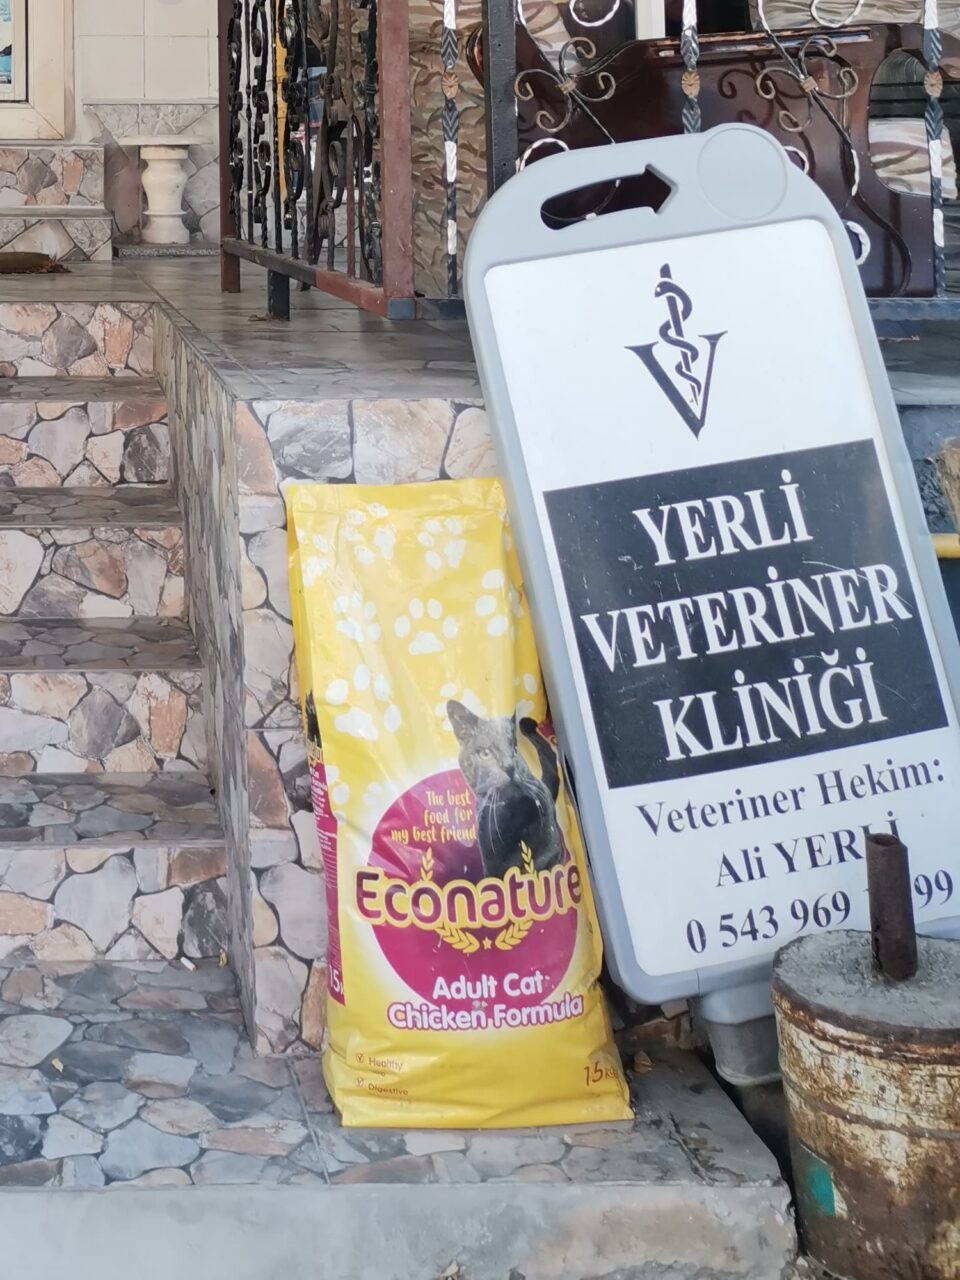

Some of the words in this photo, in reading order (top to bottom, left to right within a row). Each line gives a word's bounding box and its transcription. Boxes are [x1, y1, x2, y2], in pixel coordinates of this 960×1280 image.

[632, 469, 815, 567] YERLİ
[580, 564, 914, 674] VETERİNER
[653, 646, 890, 762] KLİNİĞİ
[424, 809, 450, 827] food
[454, 806, 473, 824] for
[425, 789, 444, 806] The
[446, 788, 472, 806] best
[634, 784, 806, 837] Veteriner
[815, 757, 945, 808] Hekim:
[390, 828, 409, 845] my
[412, 826, 437, 844] best
[440, 823, 477, 844] friend
[715, 845, 769, 888] Ali
[772, 810, 900, 876] YER
[355, 863, 582, 924] Econature
[686, 918, 707, 954] 0
[719, 904, 780, 948] 543
[790, 889, 852, 933] 969
[913, 869, 954, 910] 99
[432, 973, 498, 1000] Adult
[503, 970, 544, 997] Cat
[389, 1002, 488, 1030] Chicken
[493, 992, 583, 1028] Formula
[368, 1056, 403, 1072] Healthy
[368, 1082, 408, 1096] Digestive
